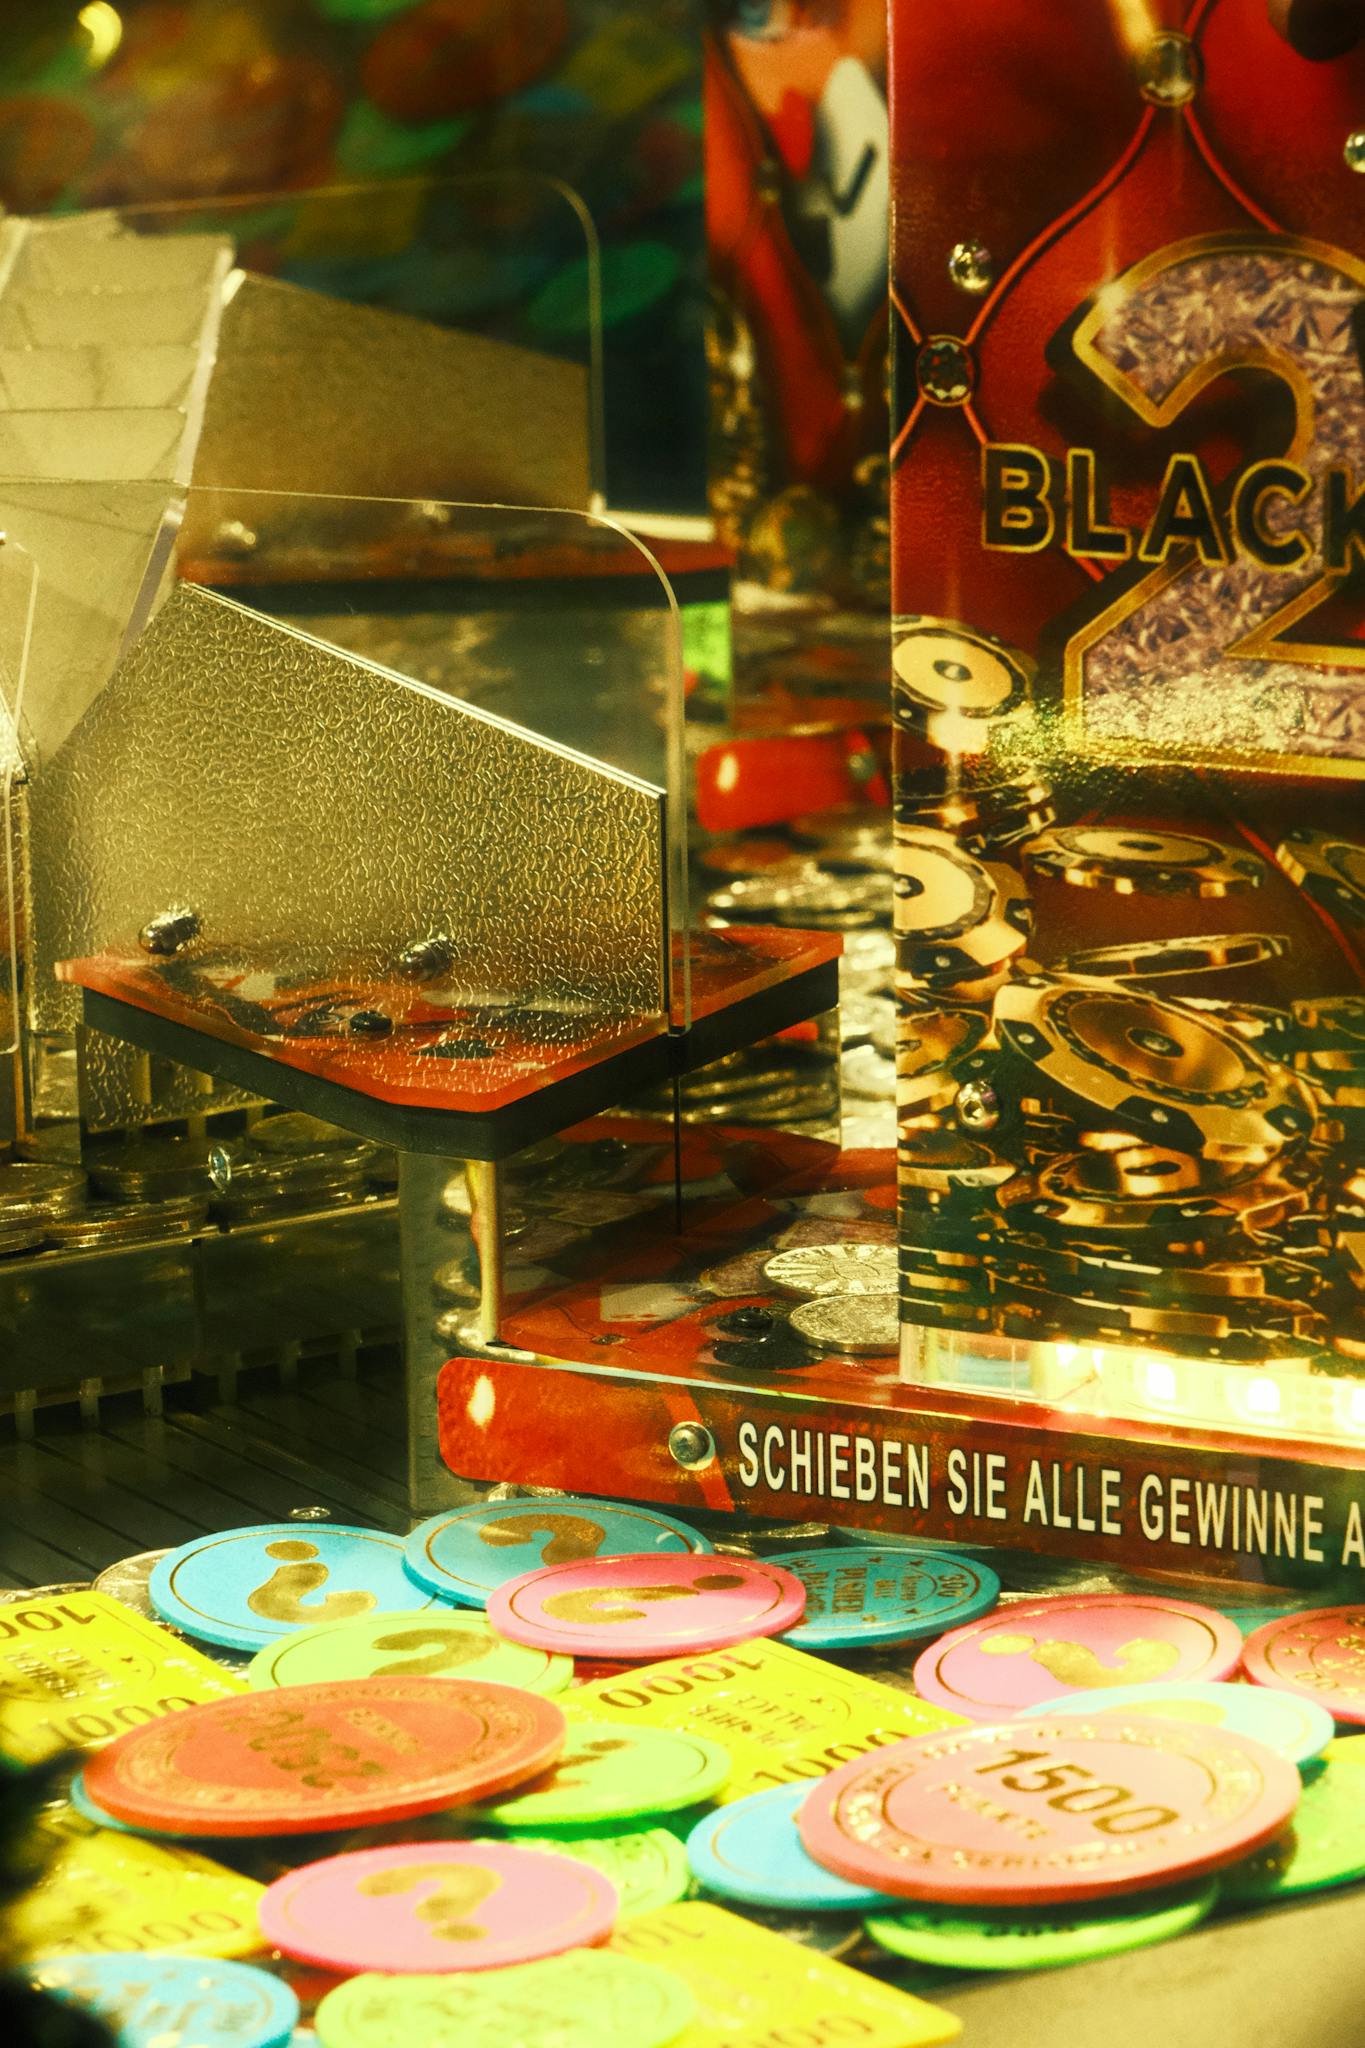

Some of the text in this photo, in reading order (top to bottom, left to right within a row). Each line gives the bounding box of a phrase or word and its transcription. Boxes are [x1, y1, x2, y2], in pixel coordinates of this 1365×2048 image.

[738, 1421, 930, 1510] SCHIEBEN
[947, 1448, 1008, 1521] SIE
[1023, 1459, 1123, 1535] ALLE
[1139, 1473, 1325, 1563] GEWINNE
[598, 1653, 766, 1710] 1000
[974, 1747, 1180, 1836] 1500
